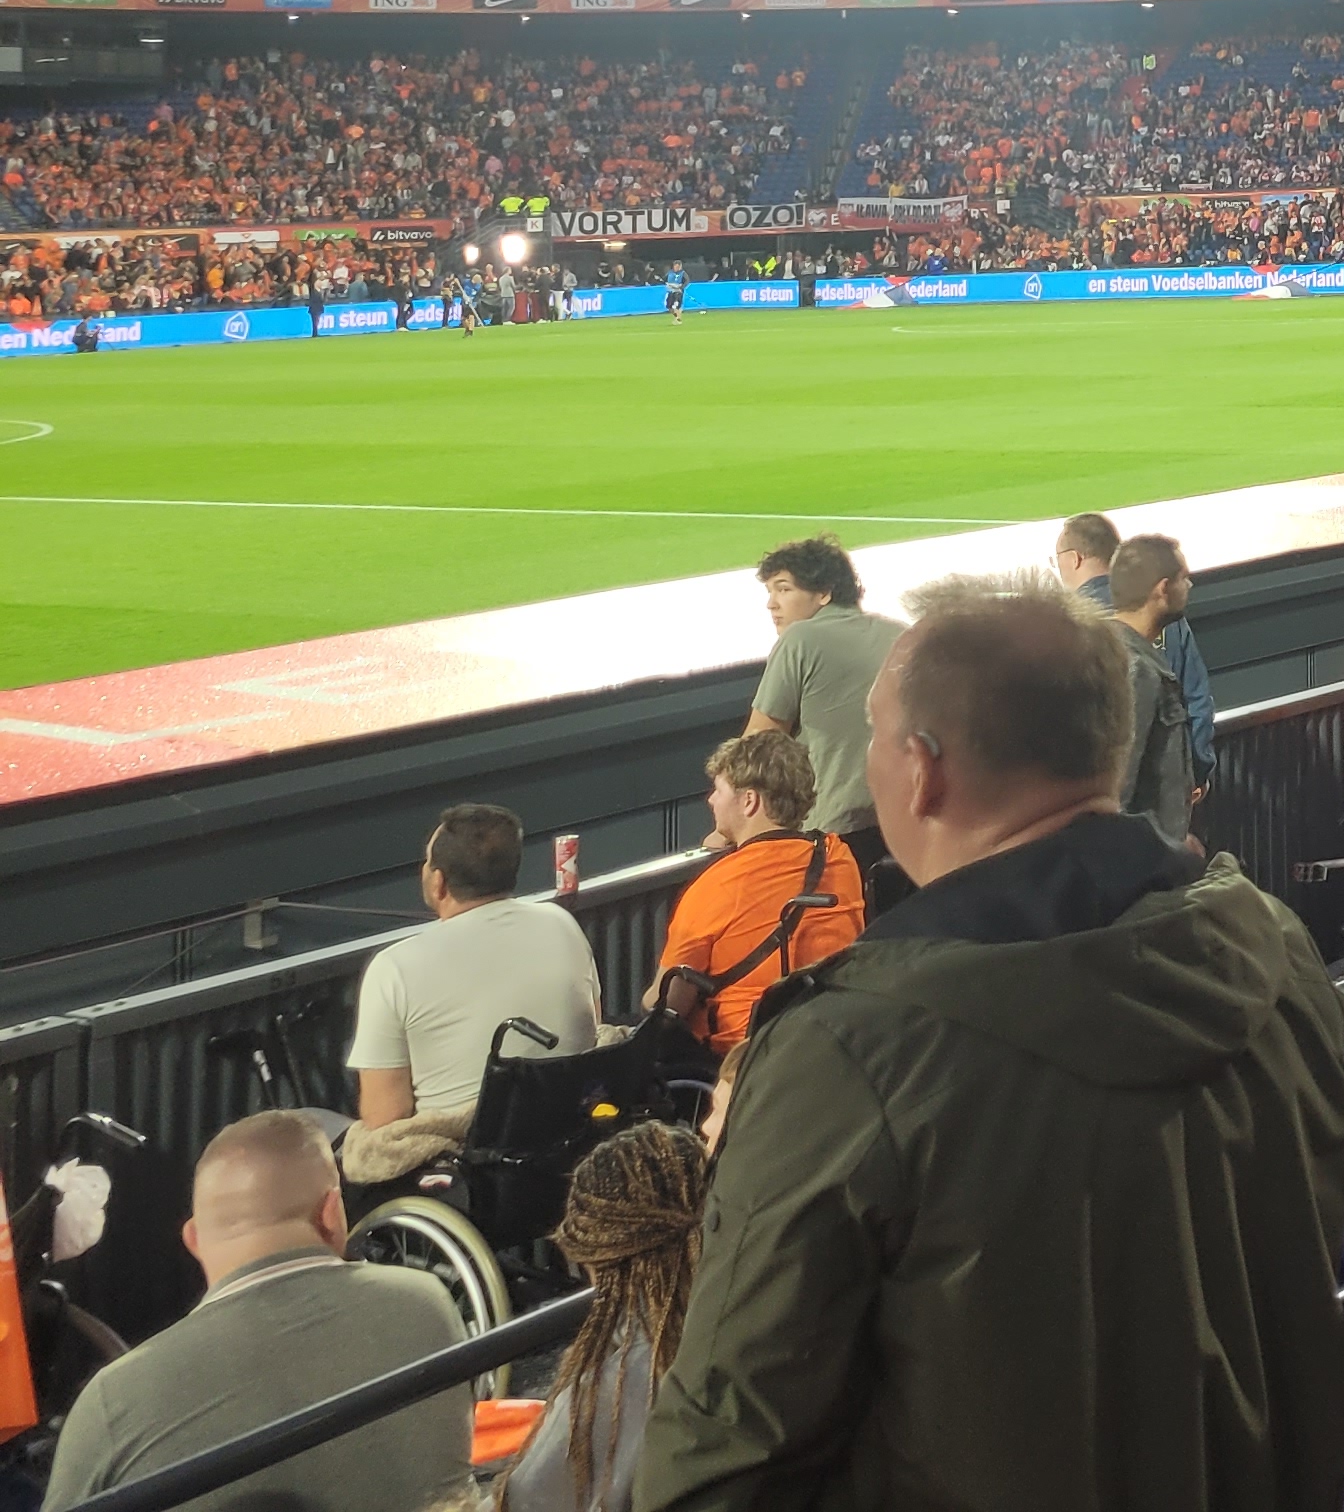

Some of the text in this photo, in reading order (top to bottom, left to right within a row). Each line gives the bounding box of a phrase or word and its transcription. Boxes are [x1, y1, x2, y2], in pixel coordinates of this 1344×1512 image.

[530, 220, 539, 229] K
[556, 208, 692, 236] VORTUM
[728, 206, 803, 228] OZO!
[387, 229, 433, 241] bitvavo
[741, 288, 757, 301] en
[760, 285, 793, 301] steun
[906, 279, 967, 298] ederland
[1089, 279, 1106, 293] en
[1108, 276, 1148, 292] steun
[1152, 271, 1262, 291] Voedselbanken
[339, 310, 388, 329] steun
